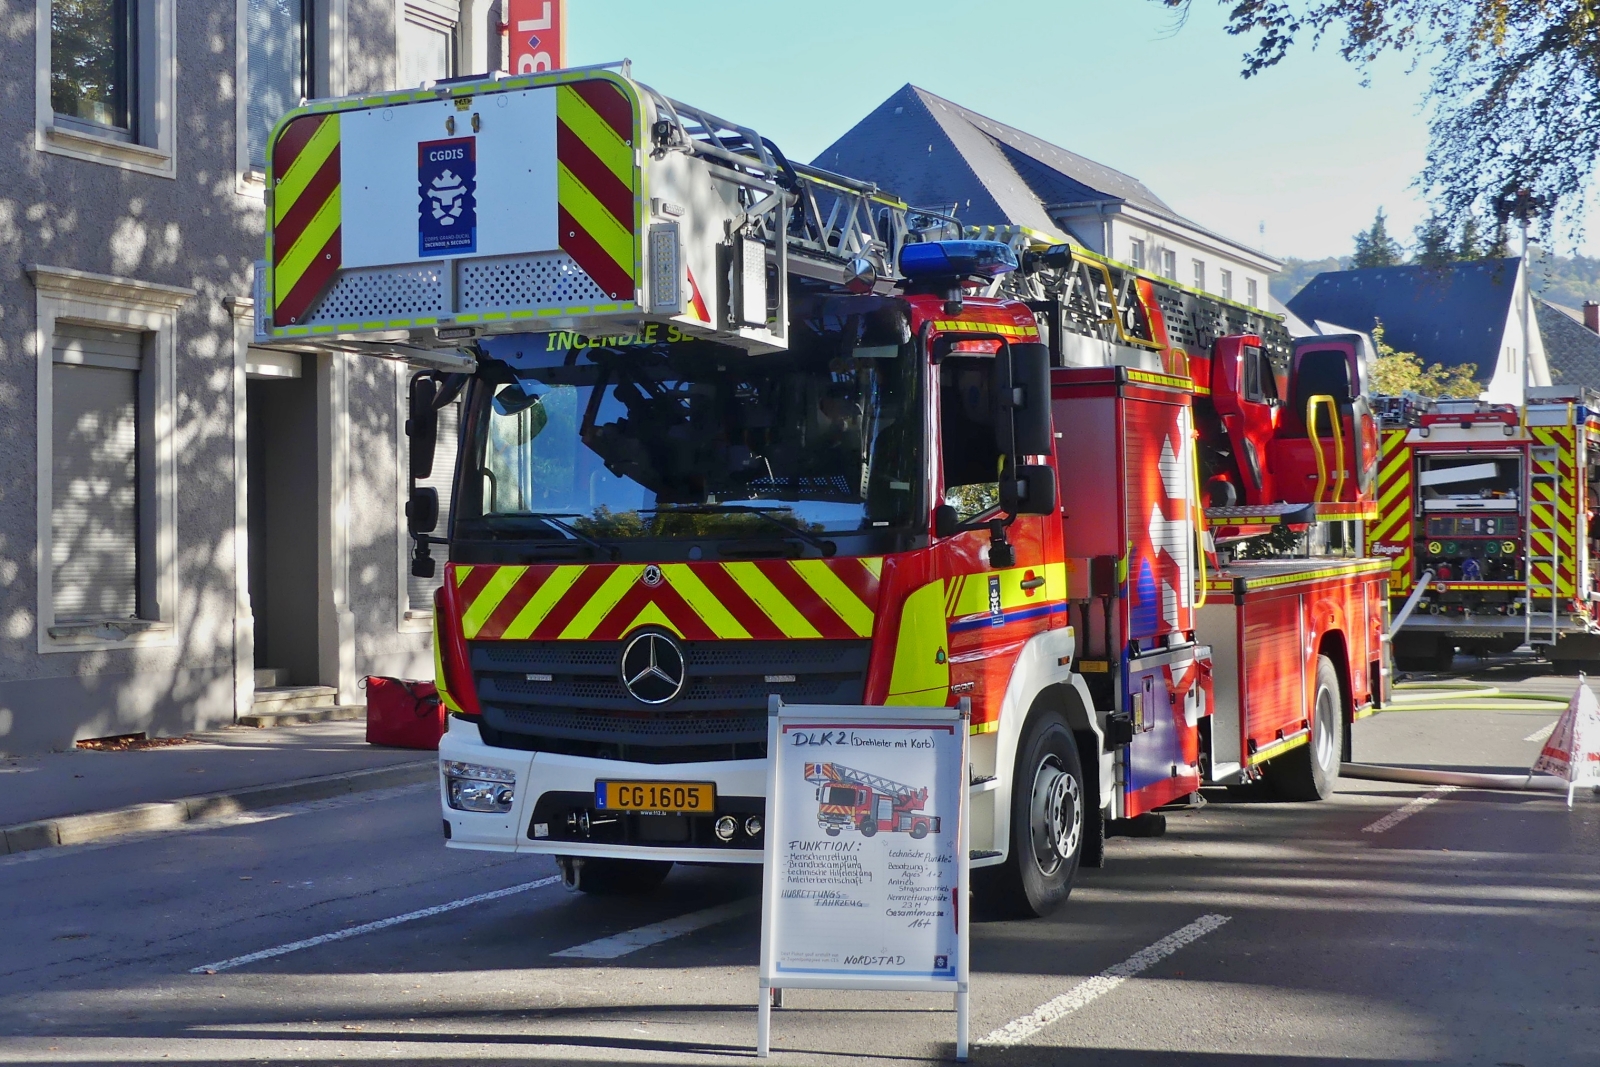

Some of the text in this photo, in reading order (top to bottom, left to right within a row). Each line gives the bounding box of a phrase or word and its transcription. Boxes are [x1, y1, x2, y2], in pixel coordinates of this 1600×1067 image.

[429, 148, 464, 162] CGDIS
[1371, 541, 1404, 556] Ziegler
[894, 739, 907, 749] mit
[843, 955, 906, 966] NORDSTAD
